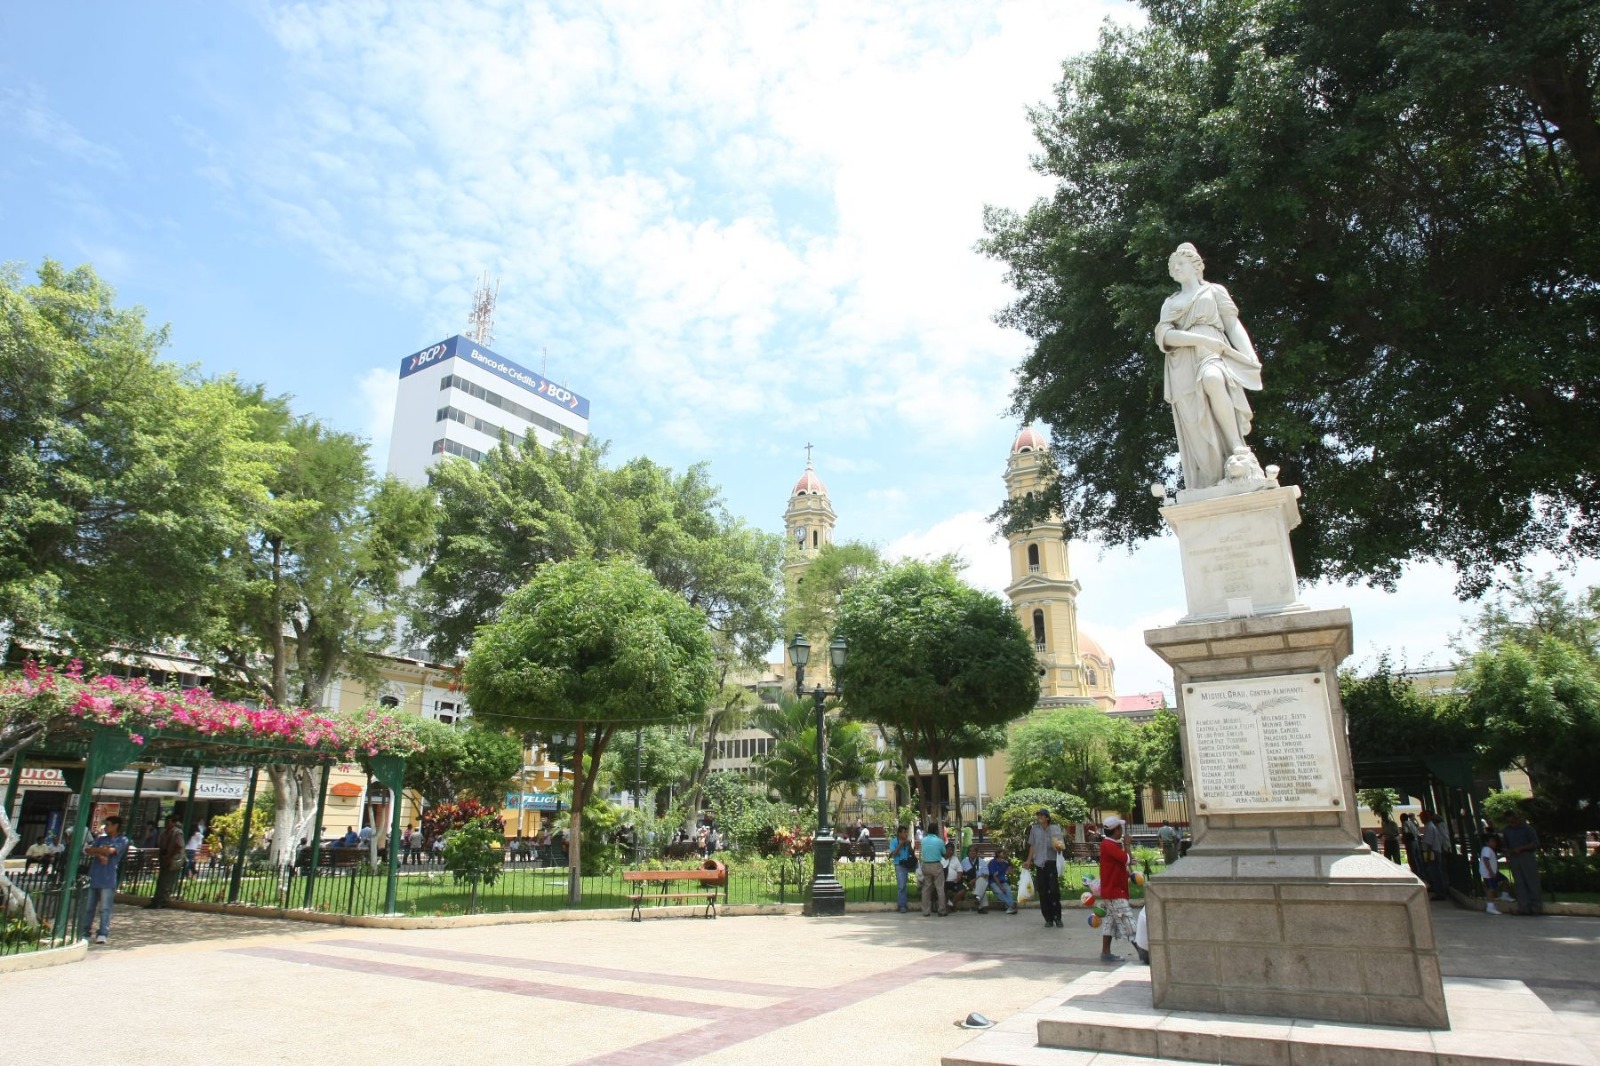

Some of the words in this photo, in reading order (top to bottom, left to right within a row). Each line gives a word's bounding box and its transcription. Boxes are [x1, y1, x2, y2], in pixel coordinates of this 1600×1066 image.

[418, 345, 440, 366] BCP
[471, 349, 497, 369] Banco
[497, 363, 508, 374] de
[508, 367, 536, 388] Crédito
[547, 384, 572, 403] BCP
[0, 767, 63, 779] OUTO
